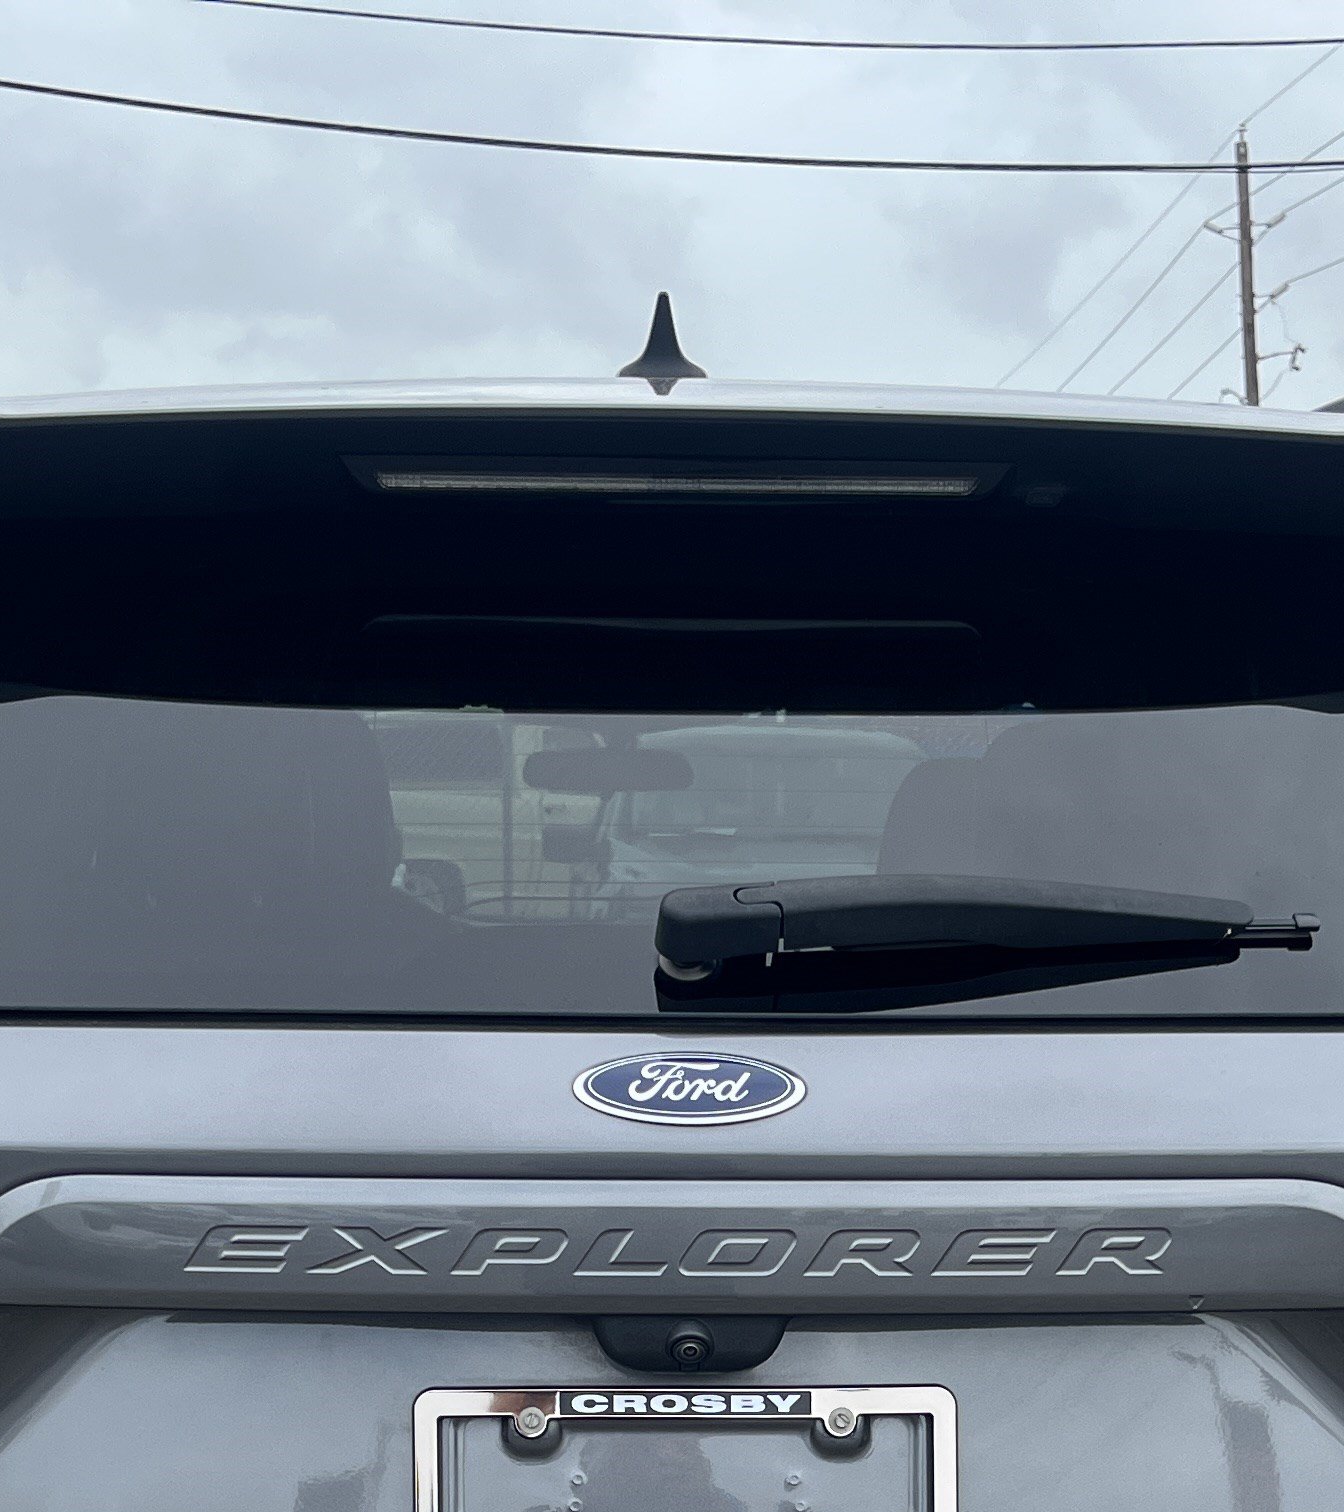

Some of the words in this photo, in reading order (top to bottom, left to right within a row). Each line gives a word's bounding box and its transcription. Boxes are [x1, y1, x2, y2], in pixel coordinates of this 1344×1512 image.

[628, 1061, 751, 1102] Ford
[182, 1222, 1175, 1279] EXPLORER
[571, 1393, 801, 1415] CROSBY
